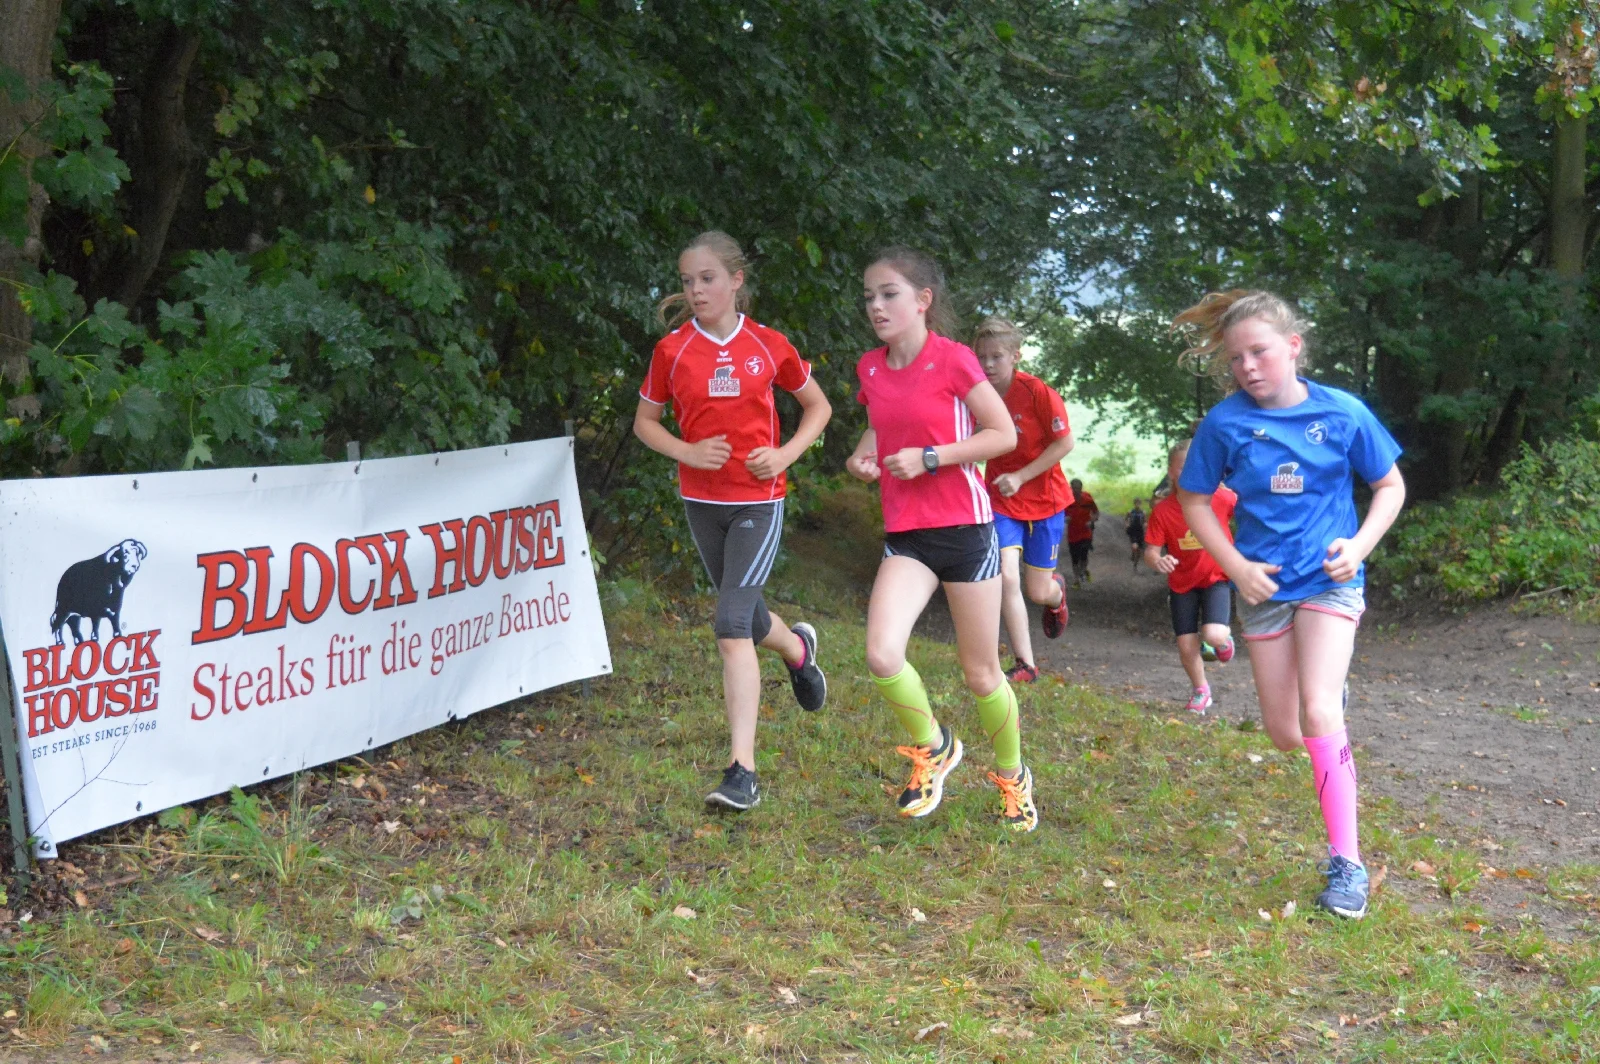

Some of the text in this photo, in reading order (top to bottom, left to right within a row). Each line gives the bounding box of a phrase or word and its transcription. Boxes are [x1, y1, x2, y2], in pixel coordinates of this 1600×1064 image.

[191, 499, 566, 645] BLOCK HOUSE
[23, 628, 162, 693] BLOCK
[190, 580, 572, 721] Steaks für die ganze Bande
[24, 671, 161, 738] HOUSE
[52, 733, 91, 754] STEAKS
[95, 725, 129, 742] SINCE
[134, 719, 157, 734] 1968
